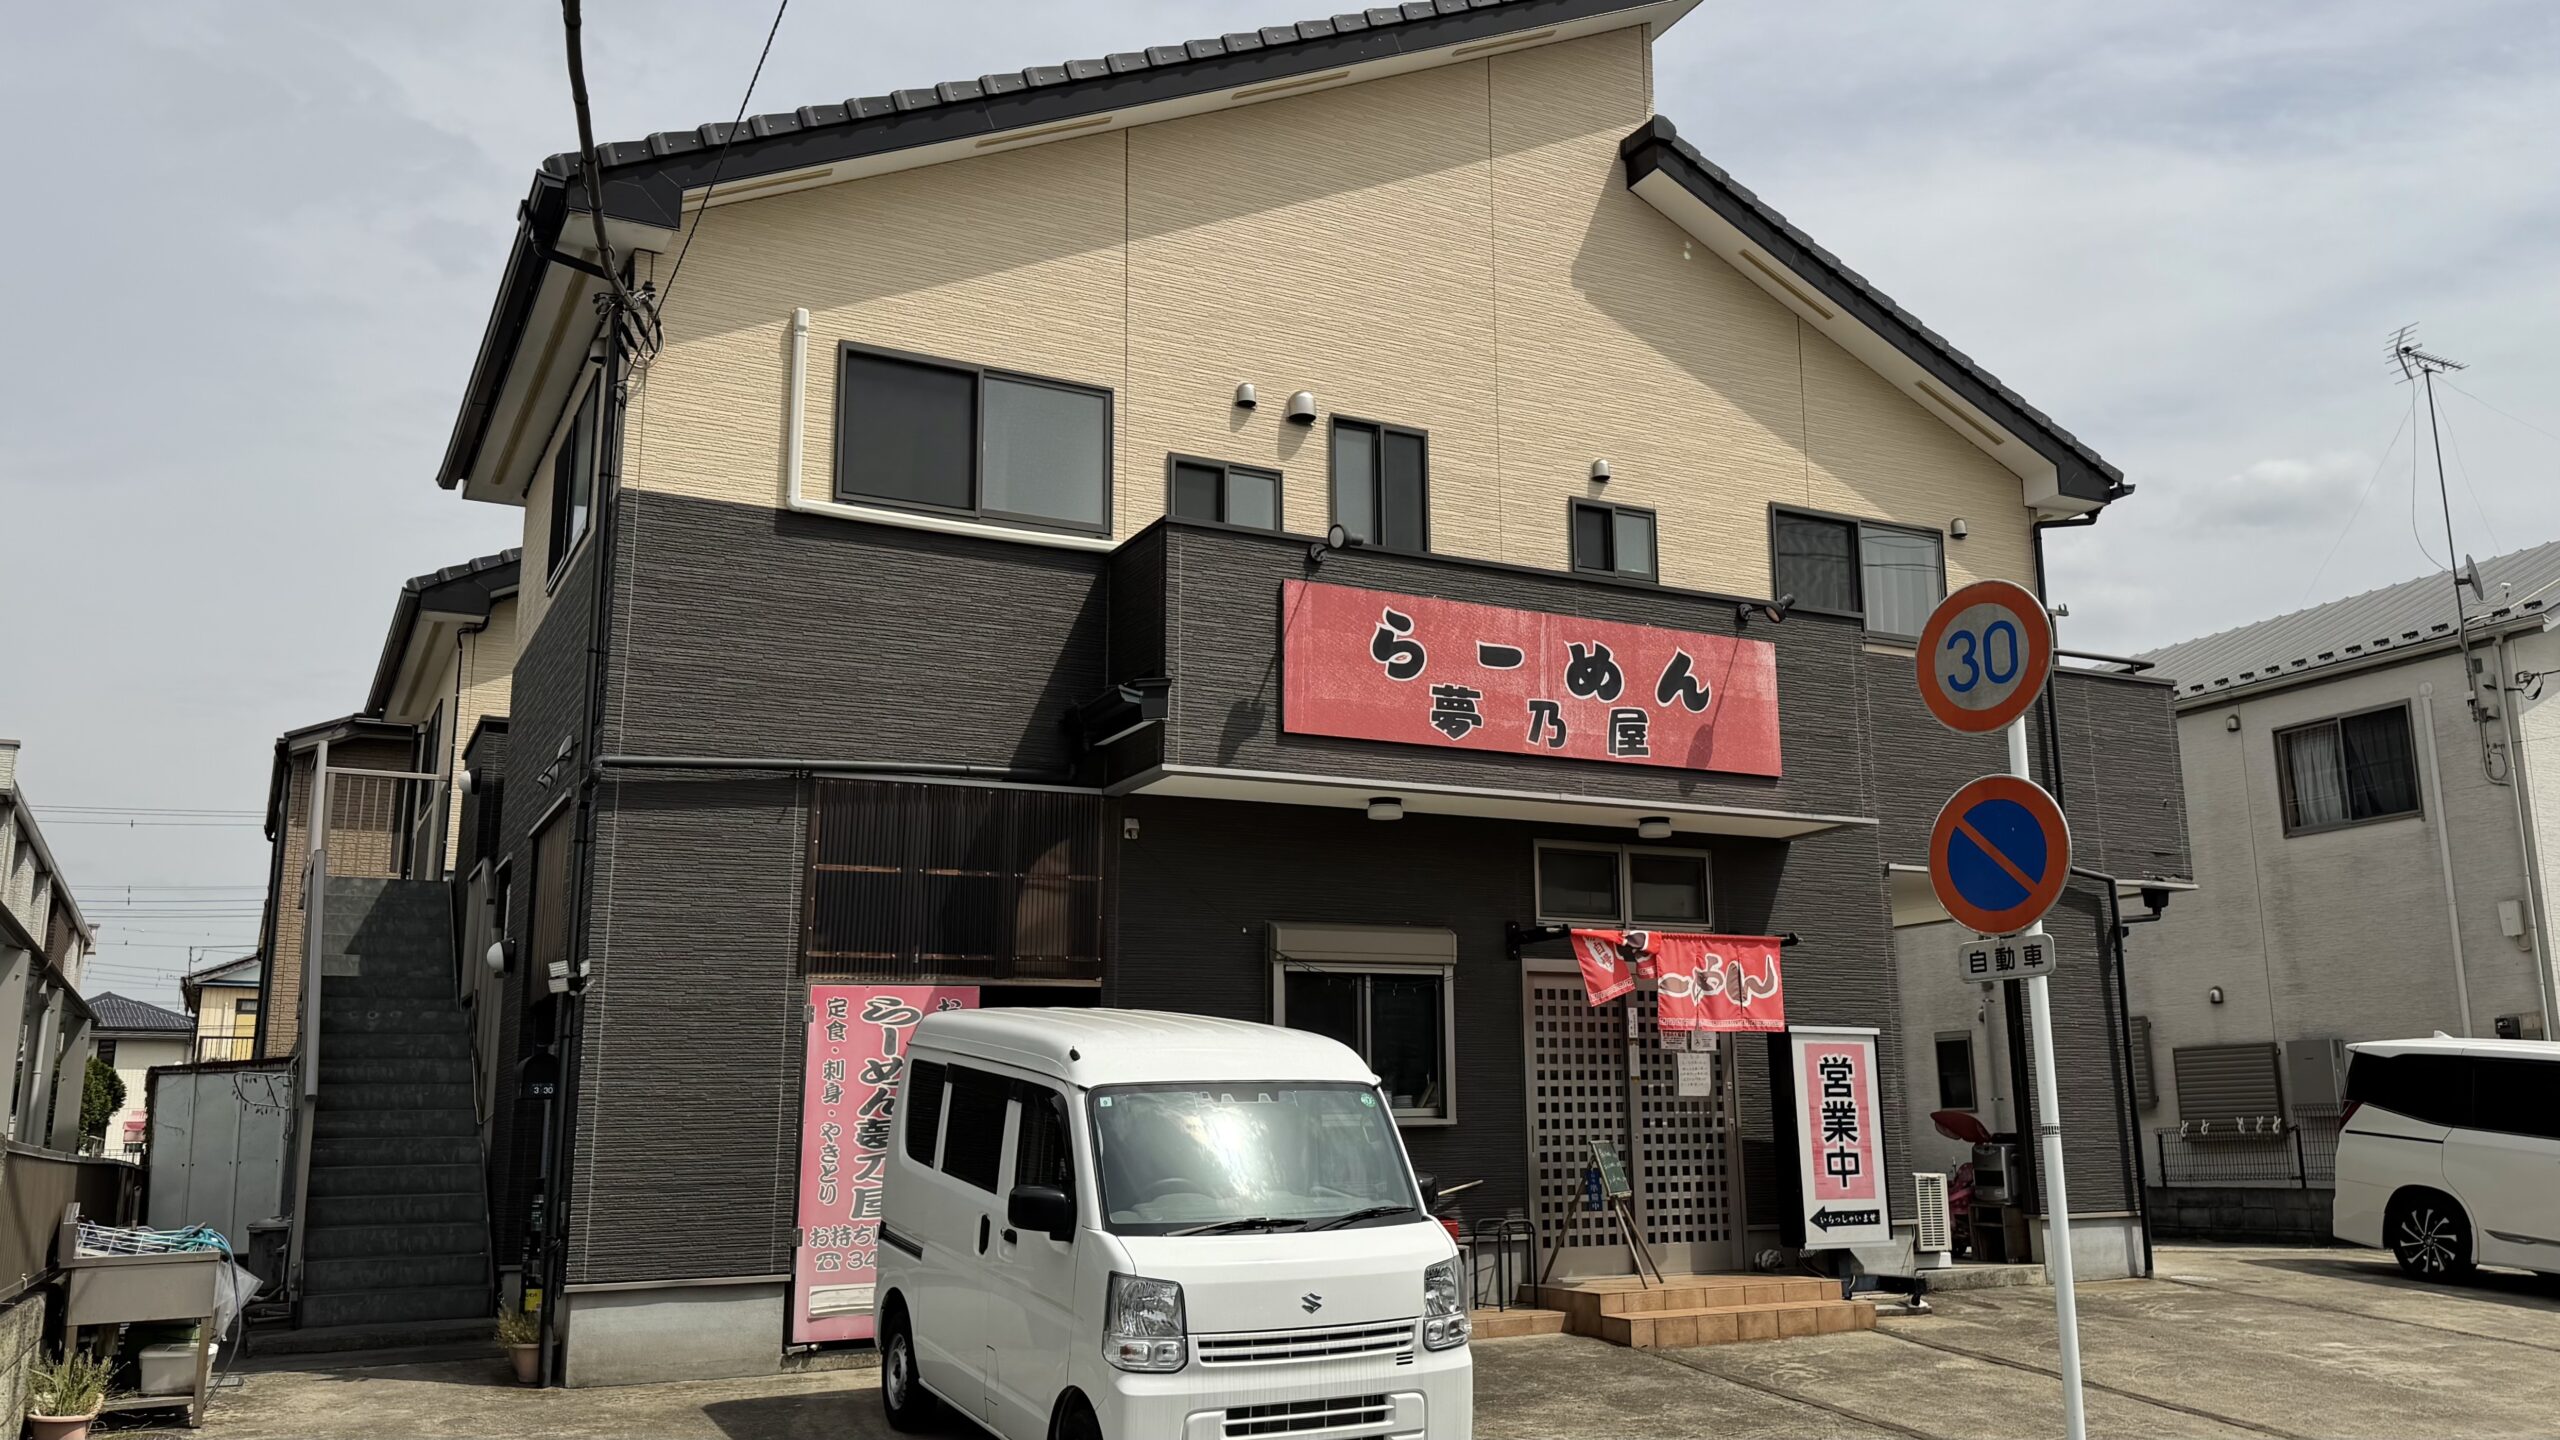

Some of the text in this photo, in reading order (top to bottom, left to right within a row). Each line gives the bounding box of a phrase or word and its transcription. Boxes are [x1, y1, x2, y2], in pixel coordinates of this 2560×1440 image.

[1370, 606, 1711, 712] らーめん
[1946, 620, 2019, 693] 30
[1429, 684, 1651, 758] 夢乃屋
[1969, 942, 2044, 974] 自動車
[1818, 1054, 1862, 1190] 営業中
[1819, 1213, 1876, 1224] いらっしゃいませ
